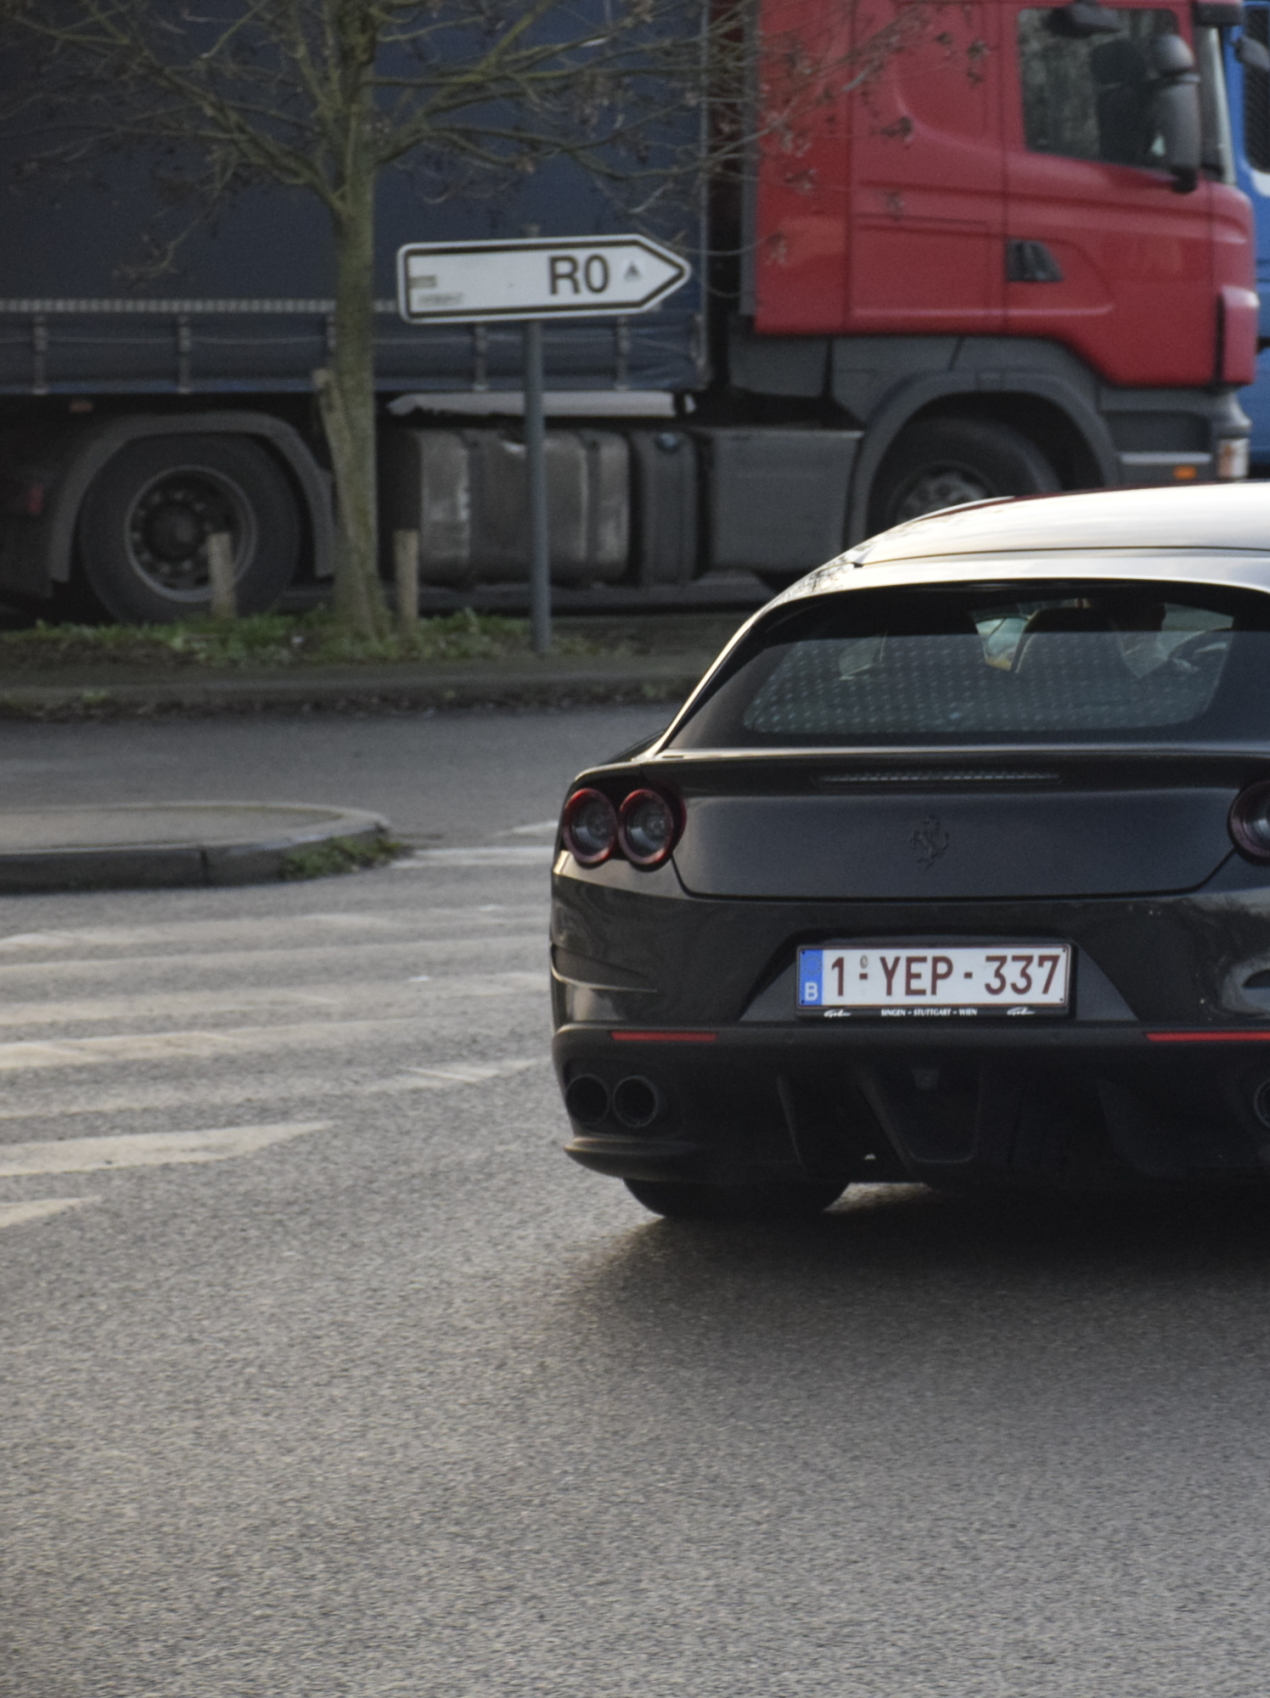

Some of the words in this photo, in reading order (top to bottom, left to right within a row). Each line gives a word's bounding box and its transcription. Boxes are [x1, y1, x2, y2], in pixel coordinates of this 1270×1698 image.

[804, 981, 819, 1002] B
[913, 1008, 952, 1017] STUTTGART
[959, 1008, 978, 1016] WIEN
